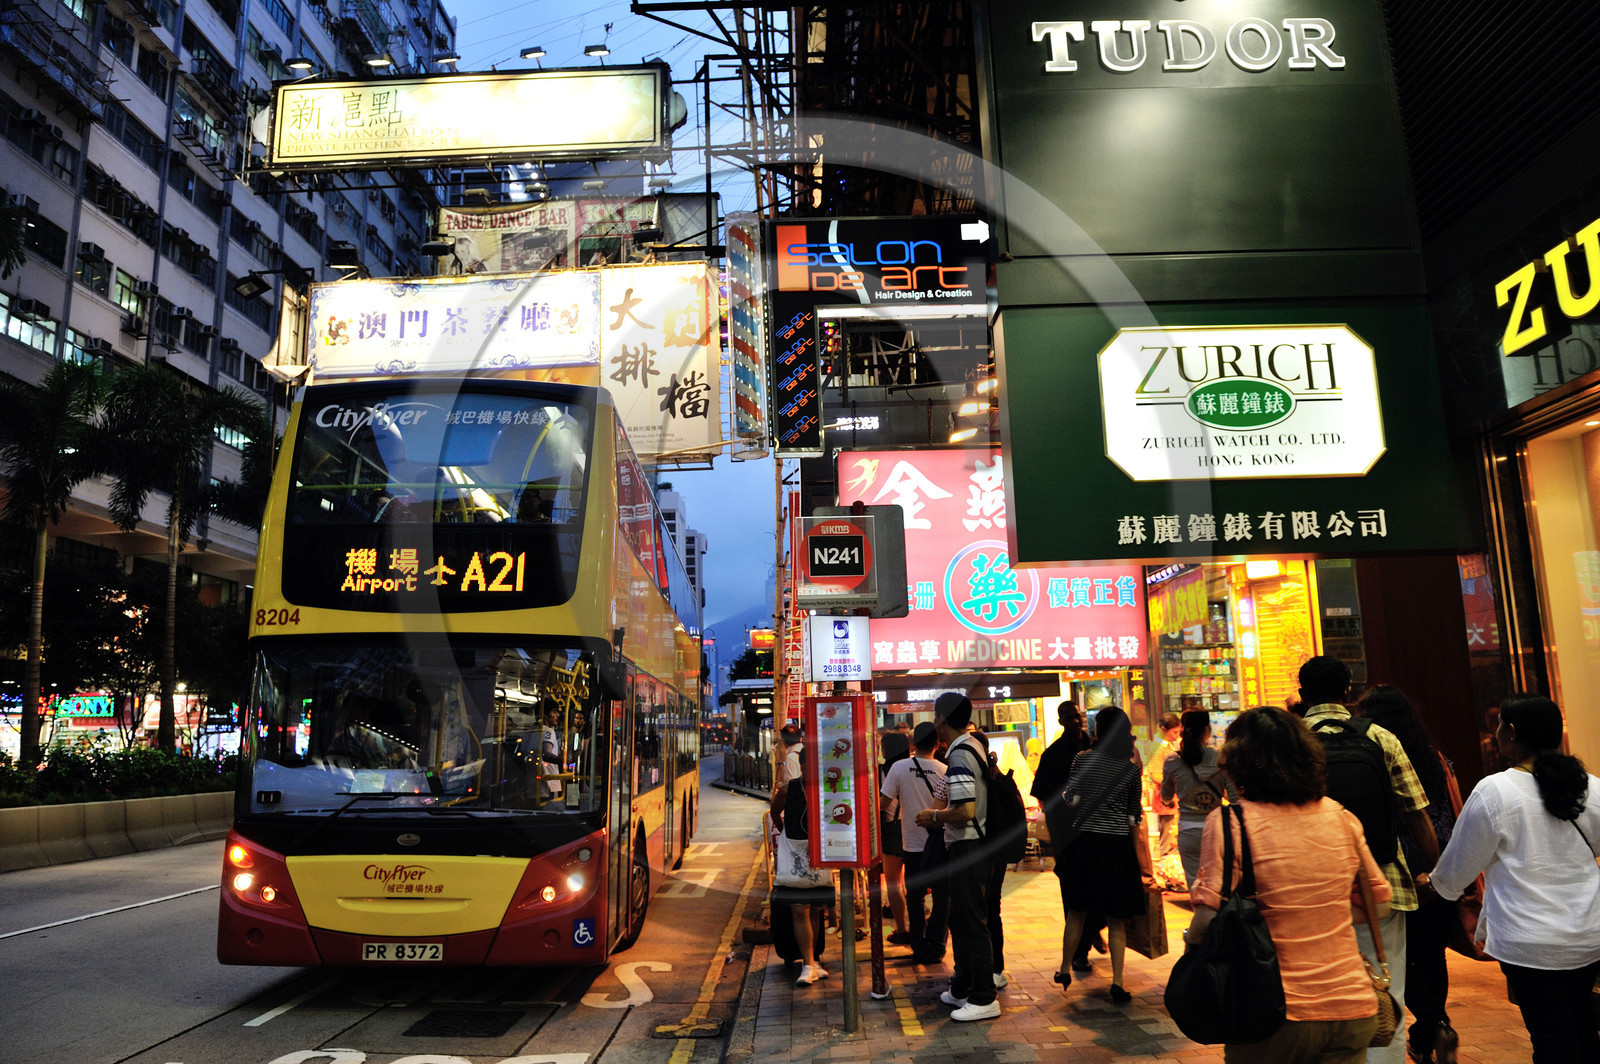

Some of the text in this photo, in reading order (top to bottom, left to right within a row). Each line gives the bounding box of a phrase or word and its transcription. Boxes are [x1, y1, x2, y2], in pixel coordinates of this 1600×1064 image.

[1031, 17, 1346, 72] TUDOR
[287, 131, 325, 142] NEW
[328, 127, 417, 140] SHANGHAI
[287, 142, 337, 153] PRIVATE
[343, 139, 403, 150] KITCHEN
[446, 206, 569, 231] TABLE DANCE BAR
[875, 289, 973, 300] Hair Design & Creation
[1135, 343, 1337, 394] ZURICH
[1196, 391, 1286, 416] 蘇麗鐘錶
[444, 410, 551, 426] 城巴機場快線
[1142, 433, 1345, 449] ZURICH WATCH CO. LTD.
[1198, 453, 1295, 467] HONG KONG
[829, 525, 850, 534] KMB
[1117, 508, 1388, 545] 蘇麗鐘錶有限公司
[345, 548, 419, 575] 機場
[814, 547, 859, 564] N241
[461, 551, 526, 592] A21
[341, 574, 418, 594] Airport
[962, 553, 1026, 621] 藥
[1047, 576, 1137, 608] 優質正貨
[255, 608, 301, 626] 8204
[947, 638, 1043, 662] MEDICINE
[1048, 636, 1139, 660] 大量批發
[988, 686, 1011, 698] Y-3
[61, 699, 110, 715] SONY
[387, 884, 444, 894] 城巴機場快線
[365, 945, 440, 959] PR 8372
